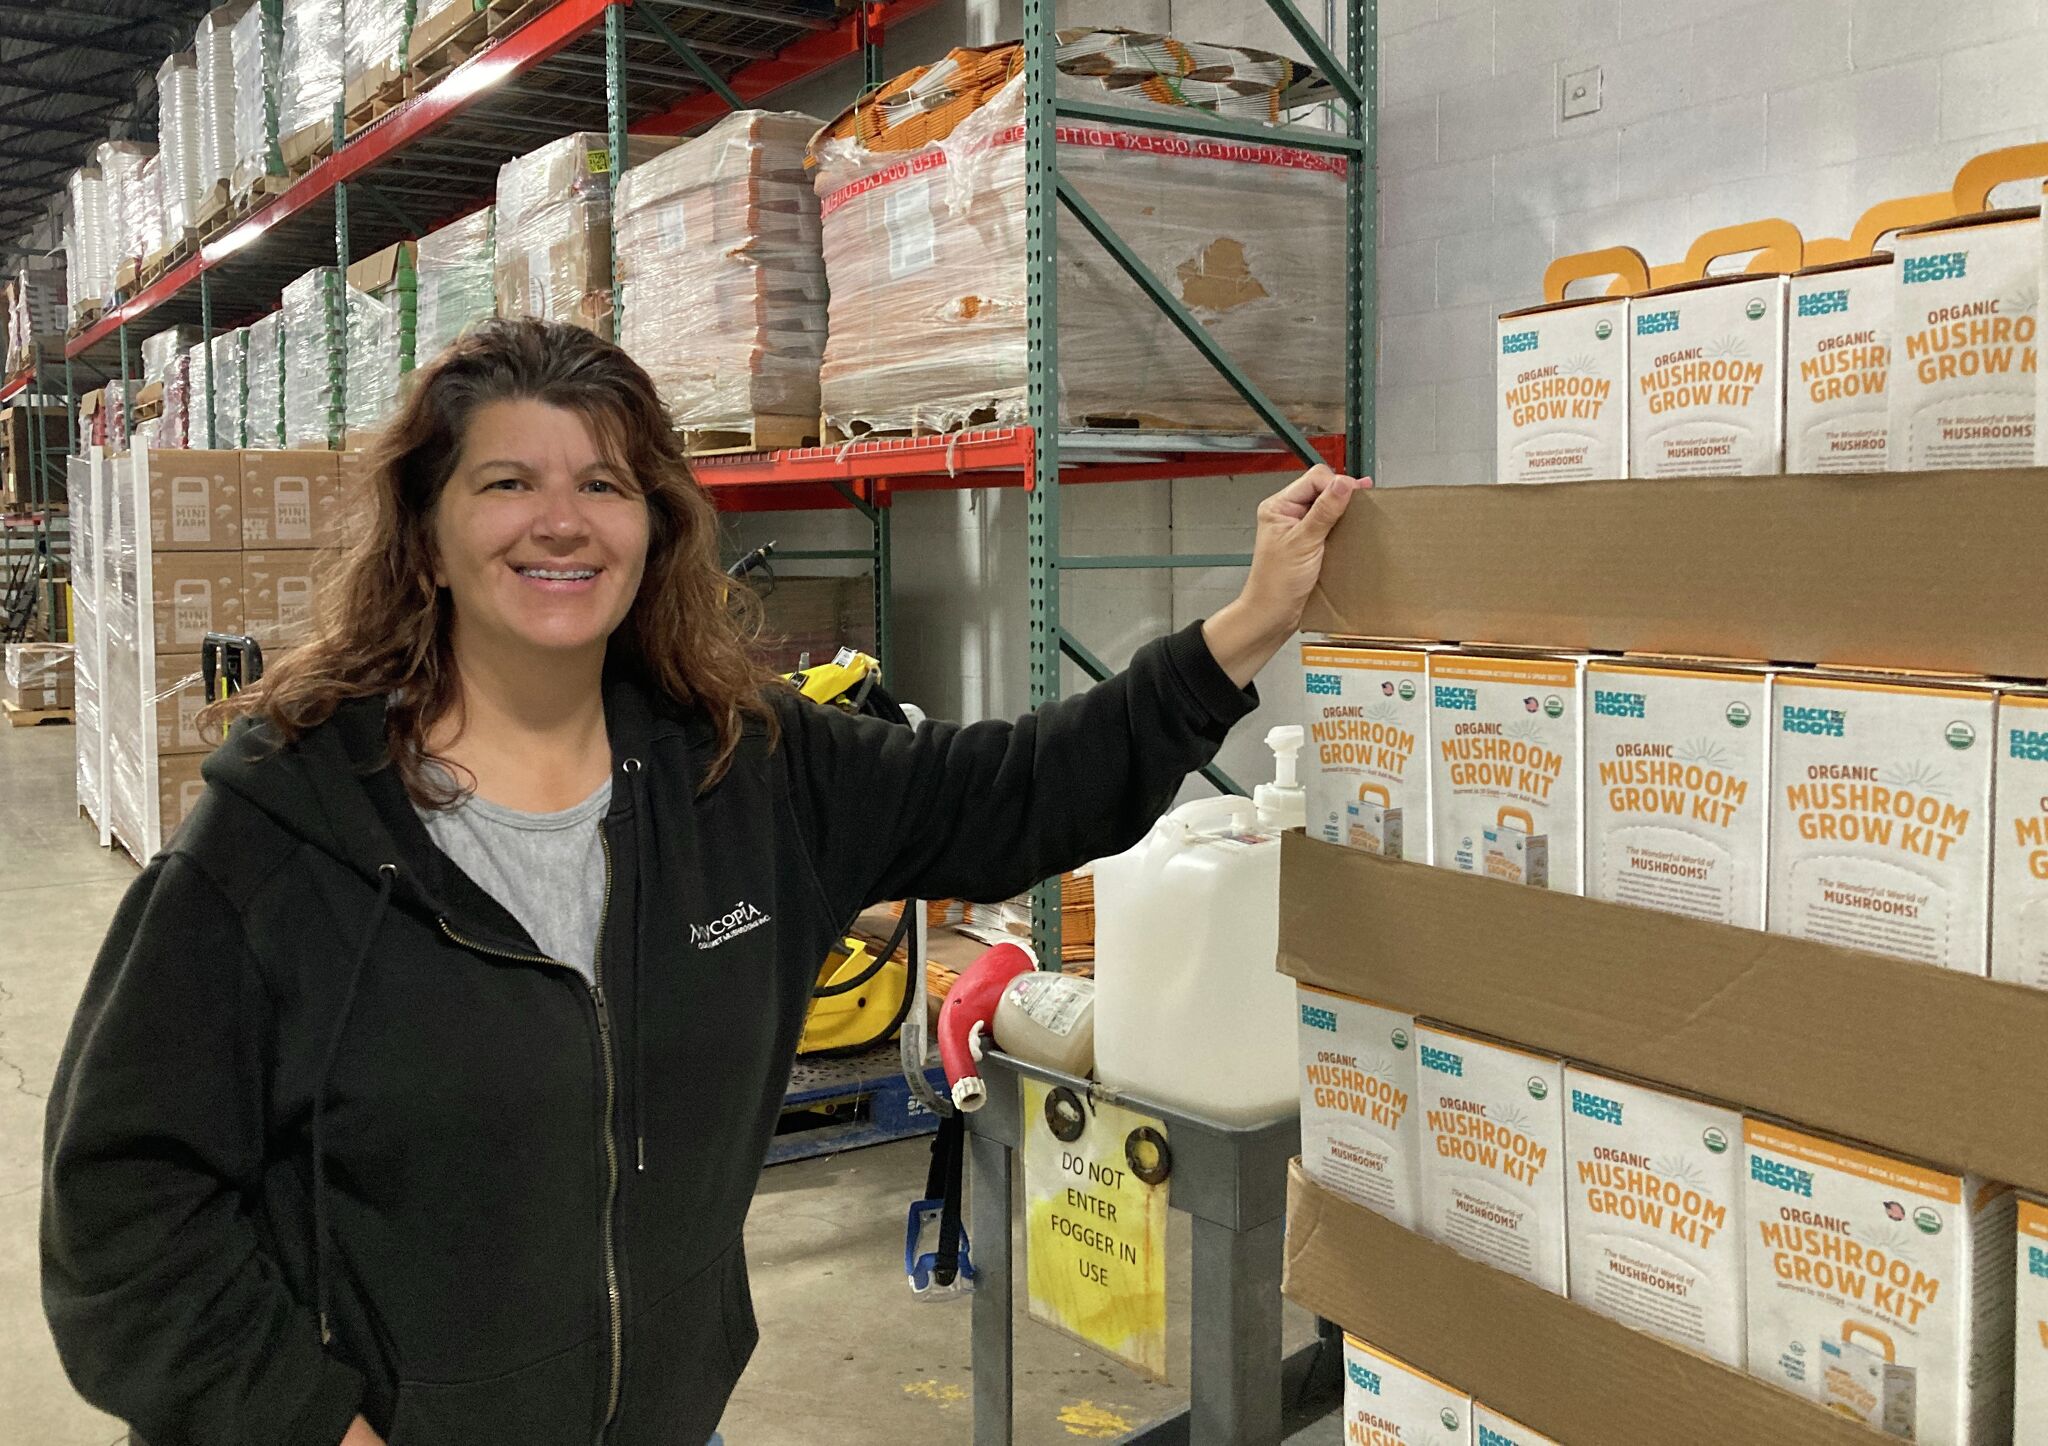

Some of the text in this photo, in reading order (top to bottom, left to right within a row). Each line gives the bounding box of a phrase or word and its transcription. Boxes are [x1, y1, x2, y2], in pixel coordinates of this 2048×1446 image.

[1904, 253, 1952, 271] BACK
[1903, 268, 1966, 284] ROOTS
[1798, 290, 1838, 306] BACK
[1637, 311, 1670, 326] BACK
[1798, 302, 1848, 317] ROOTS
[1928, 300, 2000, 324] ORGANIC
[1503, 332, 1533, 345] BACK
[1637, 322, 1679, 336] ROOTS
[1503, 342, 1538, 354] ROOTS
[1818, 330, 1875, 352] ORGANIC
[1654, 348, 1702, 368] ORGANIC
[1917, 348, 2012, 384] GROW
[1518, 365, 1559, 384] ORGANIC
[1640, 360, 1764, 395] MUSHROOM
[1506, 376, 1611, 410] MUSHROOM
[1810, 371, 1888, 403] GROW
[1649, 384, 1754, 414] GROW KIT
[1513, 400, 1603, 427] GROW KIT
[1529, 455, 1584, 468] MUSHROOMS!
[1668, 445, 1730, 458] MUSHROOMS!
[176, 509, 206, 518] MINI
[177, 518, 206, 527] FARM
[278, 507, 306, 516] MINI
[279, 516, 306, 526] FARM
[178, 608, 208, 619] MINI
[1306, 672, 1334, 684] BACK
[1306, 684, 1341, 696] ROOTS
[1434, 686, 1468, 698] BACK
[1594, 690, 1632, 704] BACK
[1323, 706, 1364, 718] ORGANIC
[1435, 698, 1476, 710] ROOTS
[1594, 703, 1644, 718] ROOTS
[1784, 706, 1830, 721] BACK
[1312, 720, 1414, 755] MUSHROOM
[1455, 722, 1502, 735] ORGANIC
[1783, 720, 1844, 736] ROOTS
[1320, 744, 1408, 774] GROW KIT
[1441, 738, 1562, 778] MUSHROOM
[1616, 744, 1673, 758] ORGANIC
[1450, 763, 1514, 788] GROW
[1518, 768, 1554, 798] KIT
[1600, 760, 1748, 804] MUSHROOM
[1808, 765, 1878, 782] ORGANIC
[1609, 788, 1736, 828] GROW KIT
[1786, 784, 1970, 836] MUSHROOM
[1799, 813, 1956, 862] GROW KIT
[1632, 857, 1707, 880] MUSHROOMS!
[1824, 890, 1918, 918] MUSHROOMS!
[1302, 1004, 1330, 1020] BACK
[1302, 1014, 1336, 1032] ROOTS
[1318, 1052, 1357, 1068] ORGANIC
[1420, 1045, 1454, 1064] BACK
[1421, 1058, 1462, 1077] ROOTS
[1306, 1065, 1408, 1114] MUSHROOM
[1572, 1089, 1612, 1110] BACK
[1314, 1088, 1401, 1130] GROW KIT
[1440, 1096, 1486, 1117] ORGANIC
[1572, 1104, 1622, 1126] ROOTS
[1426, 1110, 1548, 1168] MUSHROOM
[1332, 1146, 1383, 1172] MUSHROOMS!
[1436, 1134, 1539, 1186] GROW KIT
[1594, 1146, 1651, 1170] ORGANIC
[1751, 1154, 1798, 1178] BACK
[1062, 1152, 1125, 1190] DO NOT
[1751, 1167, 1812, 1198] ROOTS
[1067, 1188, 1117, 1222] ENTER
[1578, 1161, 1726, 1229] MUSHROOM
[1456, 1199, 1517, 1230] MUSHROOMS!
[1587, 1188, 1715, 1249] GROW KIT
[1780, 1206, 1851, 1236] ORGANIC
[1051, 1214, 1136, 1265] FOGGER IN
[1080, 1258, 1108, 1287] USE
[1760, 1220, 1940, 1304] MUSHROOM
[1610, 1260, 1687, 1296] MUSHROOMS!
[1773, 1252, 1866, 1299] GROW
[1874, 1282, 1926, 1325] KIT
[1358, 1410, 1401, 1438] ORGANIC
